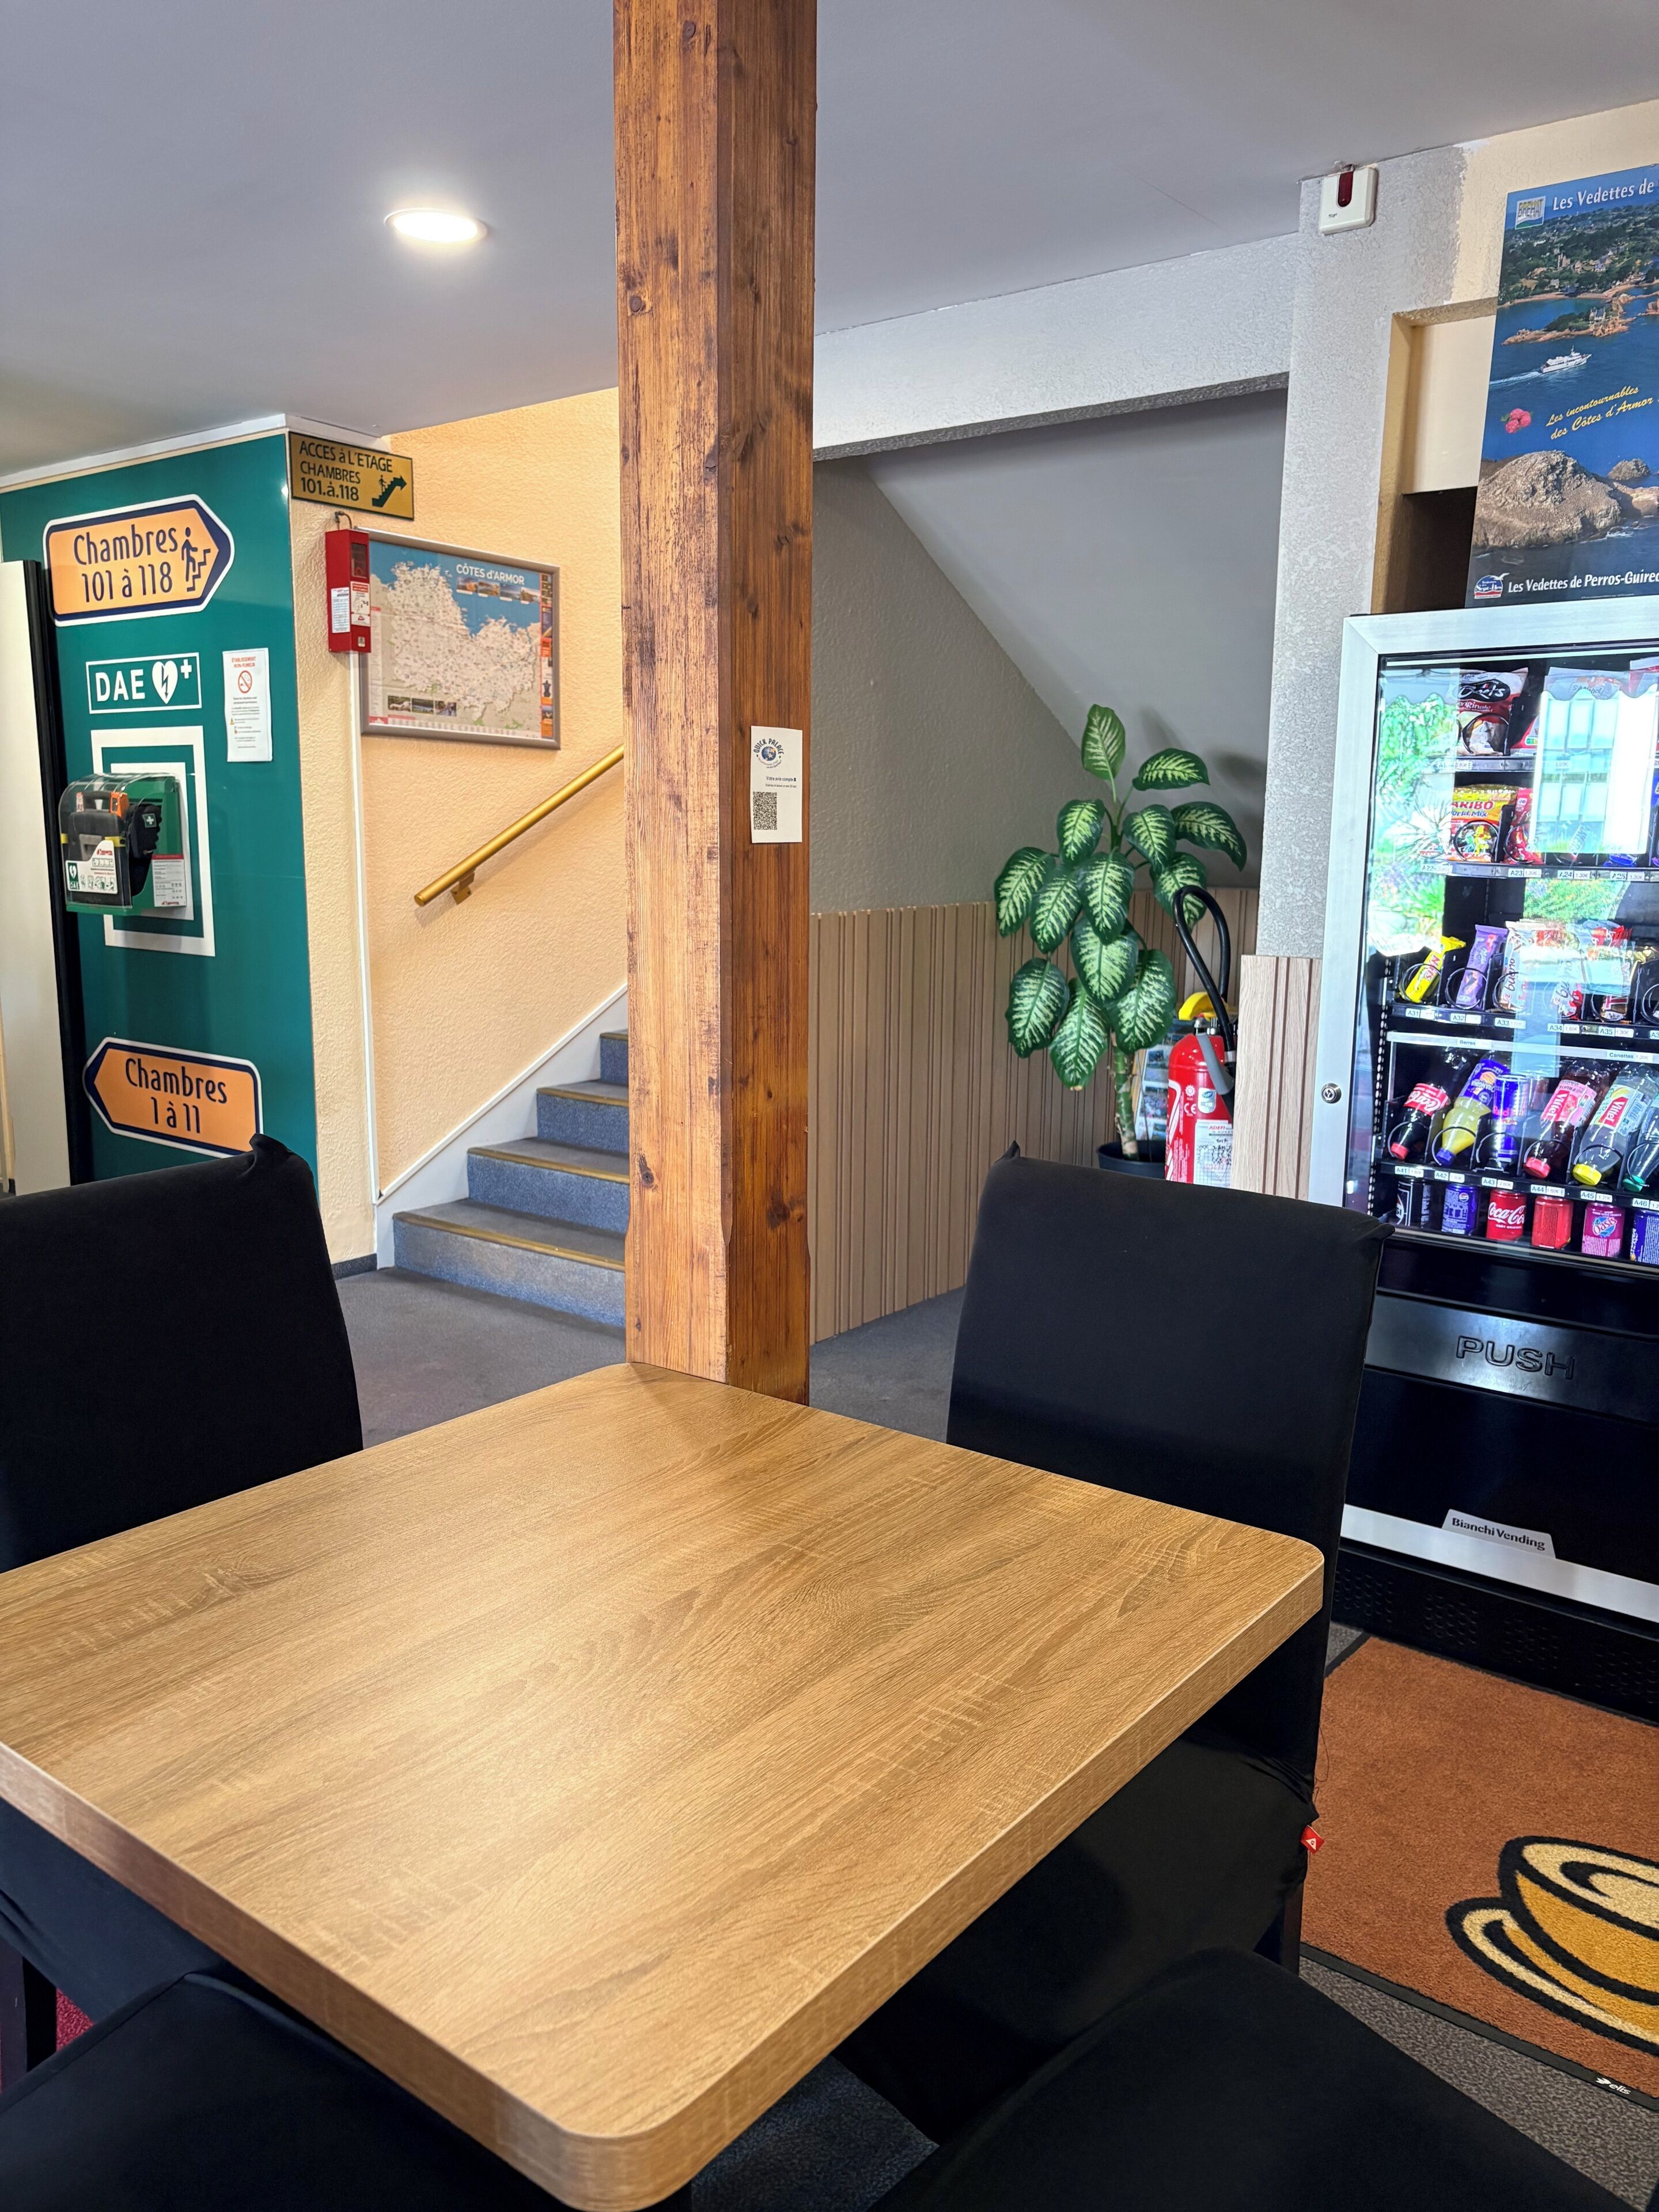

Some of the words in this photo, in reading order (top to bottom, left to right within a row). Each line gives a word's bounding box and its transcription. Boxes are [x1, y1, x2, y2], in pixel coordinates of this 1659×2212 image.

[1554, 197, 1573, 211] Les
[1577, 184, 1635, 206] Vedettes
[1639, 178, 1655, 195] de
[1546, 414, 1564, 427] Les
[1566, 385, 1639, 417] incontournables
[1551, 427, 1568, 440] des
[1571, 413, 1603, 431] Côtes
[1605, 397, 1654, 418] d'Armor
[300, 441, 336, 461] ACCES
[339, 443, 346, 461] à
[348, 445, 393, 473] L'ETAGE
[300, 461, 361, 484] CHAMBRES
[73, 524, 179, 566] Chambres
[82, 571, 115, 603] 101
[122, 568, 133, 598] à
[138, 563, 173, 595] 118
[456, 563, 486, 578] CÔTES
[1508, 582, 1524, 593] Les
[1527, 577, 1569, 592] Vedettes
[1570, 575, 1582, 589] de
[95, 669, 146, 702] DAE
[753, 738, 767, 753] QUICK
[768, 737, 785, 755] PALACE
[1451, 800, 1495, 810] ARIBO
[1504, 957, 1516, 991] bueno
[125, 1058, 228, 1104] Chambres
[150, 1096, 158, 1125] 1
[166, 1101, 177, 1128] à
[183, 1103, 201, 1134] 11
[1184, 1103, 1196, 1115] CE
[1547, 1093, 1566, 1120] Vittel
[1605, 1100, 1625, 1123] Vittel
[1592, 1216, 1618, 1236] Oasis
[1455, 1335, 1576, 1380] PUSH
[1452, 1517, 1495, 1537] Bianchi
[1495, 1527, 1546, 1552] Vending
[1608, 2084, 1631, 2094] elis
